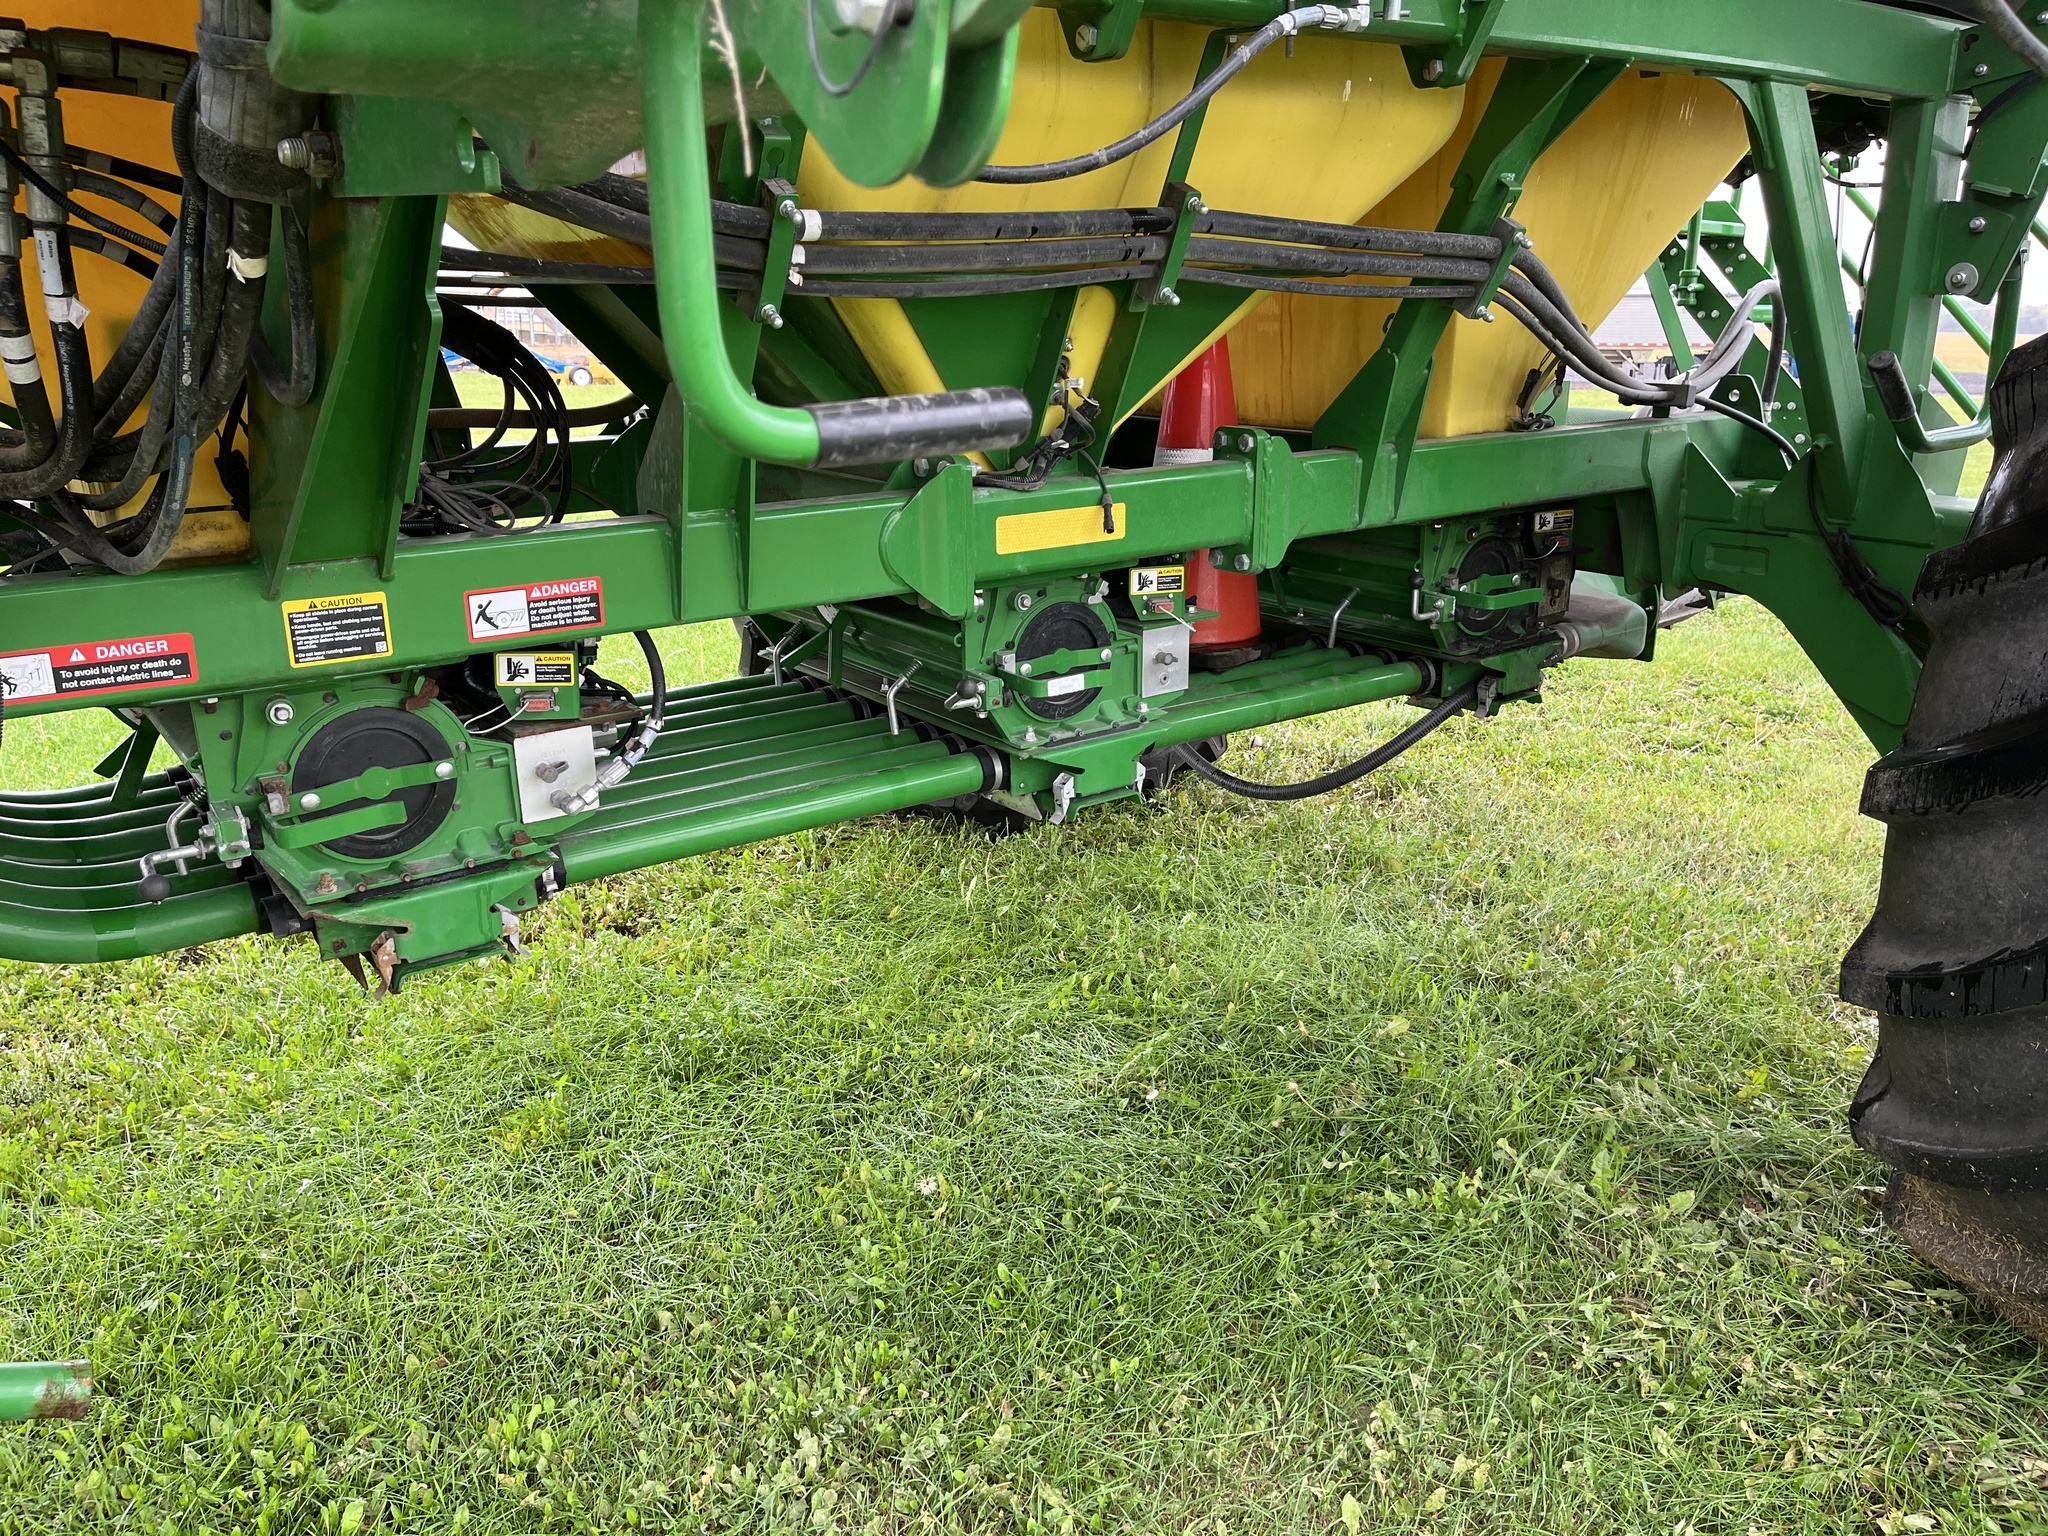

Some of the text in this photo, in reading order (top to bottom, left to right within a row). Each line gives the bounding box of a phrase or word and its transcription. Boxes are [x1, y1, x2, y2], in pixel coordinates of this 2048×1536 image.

[542, 580, 597, 596] DANGER
[321, 597, 362, 608] CAUTION
[96, 640, 168, 659] DANGER
[74, 667, 99, 677] avoid
[102, 664, 128, 674] injury
[142, 659, 167, 669] death
[62, 681, 78, 689] not
[80, 675, 115, 686] contact
[117, 671, 150, 682] electric
[152, 670, 174, 678] lines
